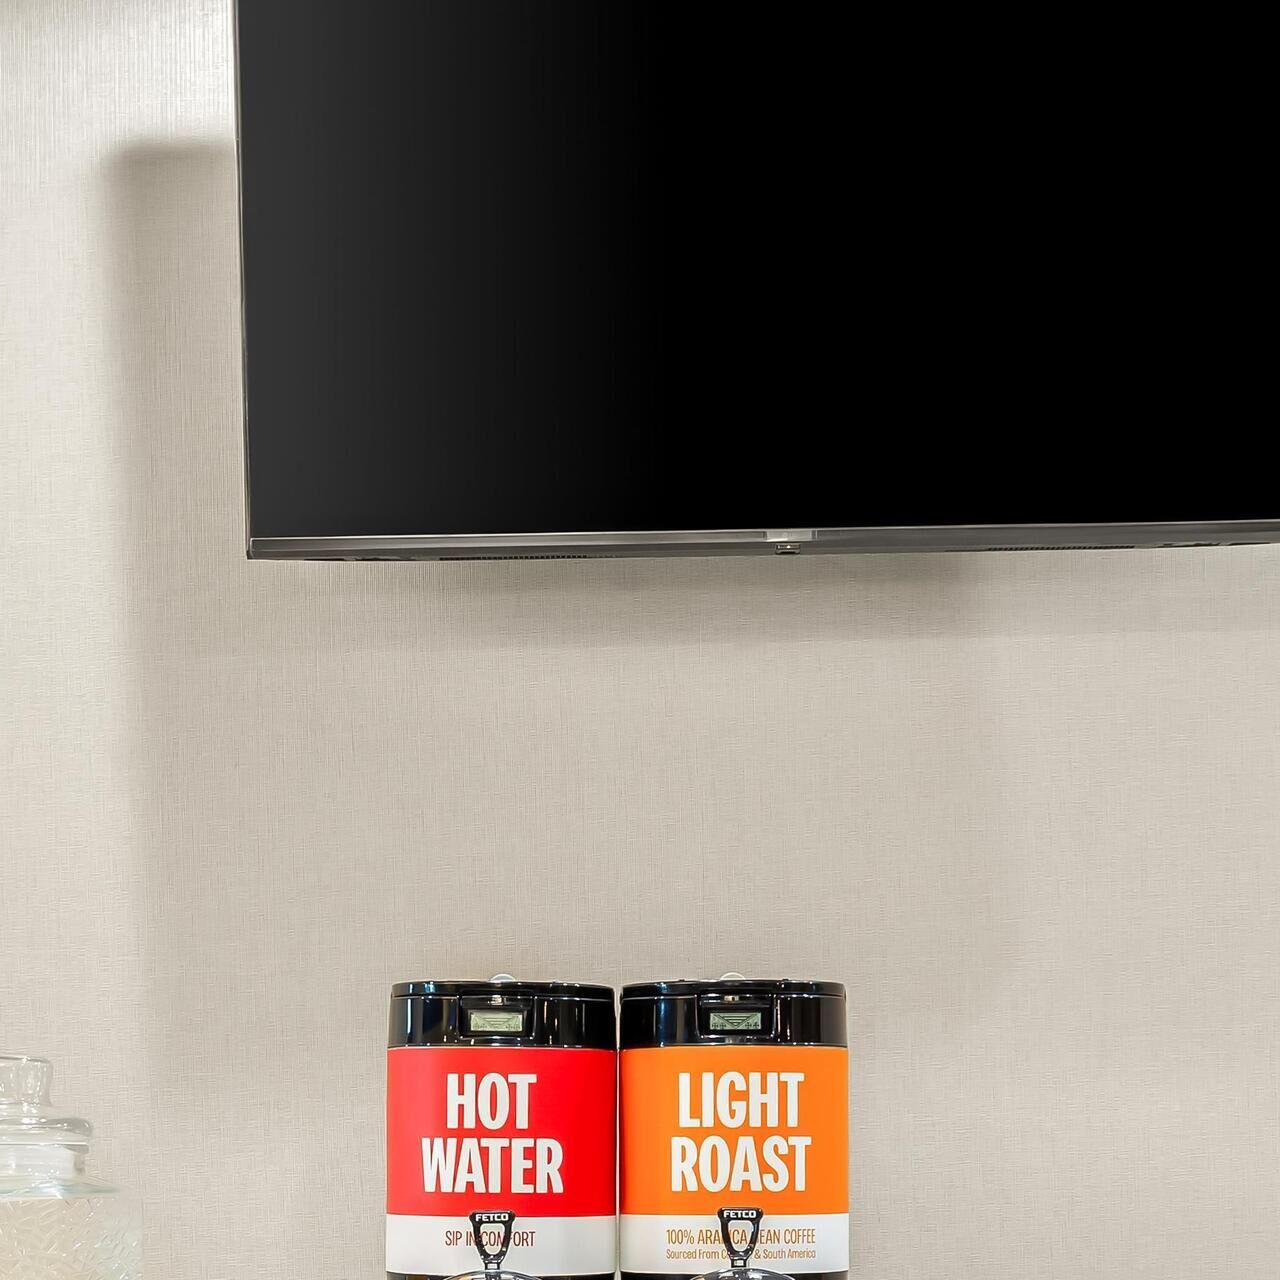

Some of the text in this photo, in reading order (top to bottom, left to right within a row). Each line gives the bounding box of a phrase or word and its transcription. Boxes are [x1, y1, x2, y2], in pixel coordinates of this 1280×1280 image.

[446, 1072, 538, 1130] HOT
[678, 1071, 805, 1129] LIGHT
[421, 1137, 564, 1194] WATER
[671, 1135, 812, 1193] ROAST
[475, 1213, 509, 1222] FETCO
[723, 1210, 757, 1218] FETCO
[445, 1230, 463, 1247] SIP
[465, 1231, 477, 1247] IN
[666, 1228, 816, 1245] 100% ARACA EAN COFFEE
[666, 1248, 697, 1260] Sourced
[698, 1249, 720, 1259] From
[754, 1249, 761, 1260] &
[763, 1248, 785, 1259] South
[787, 1248, 816, 1259] America
